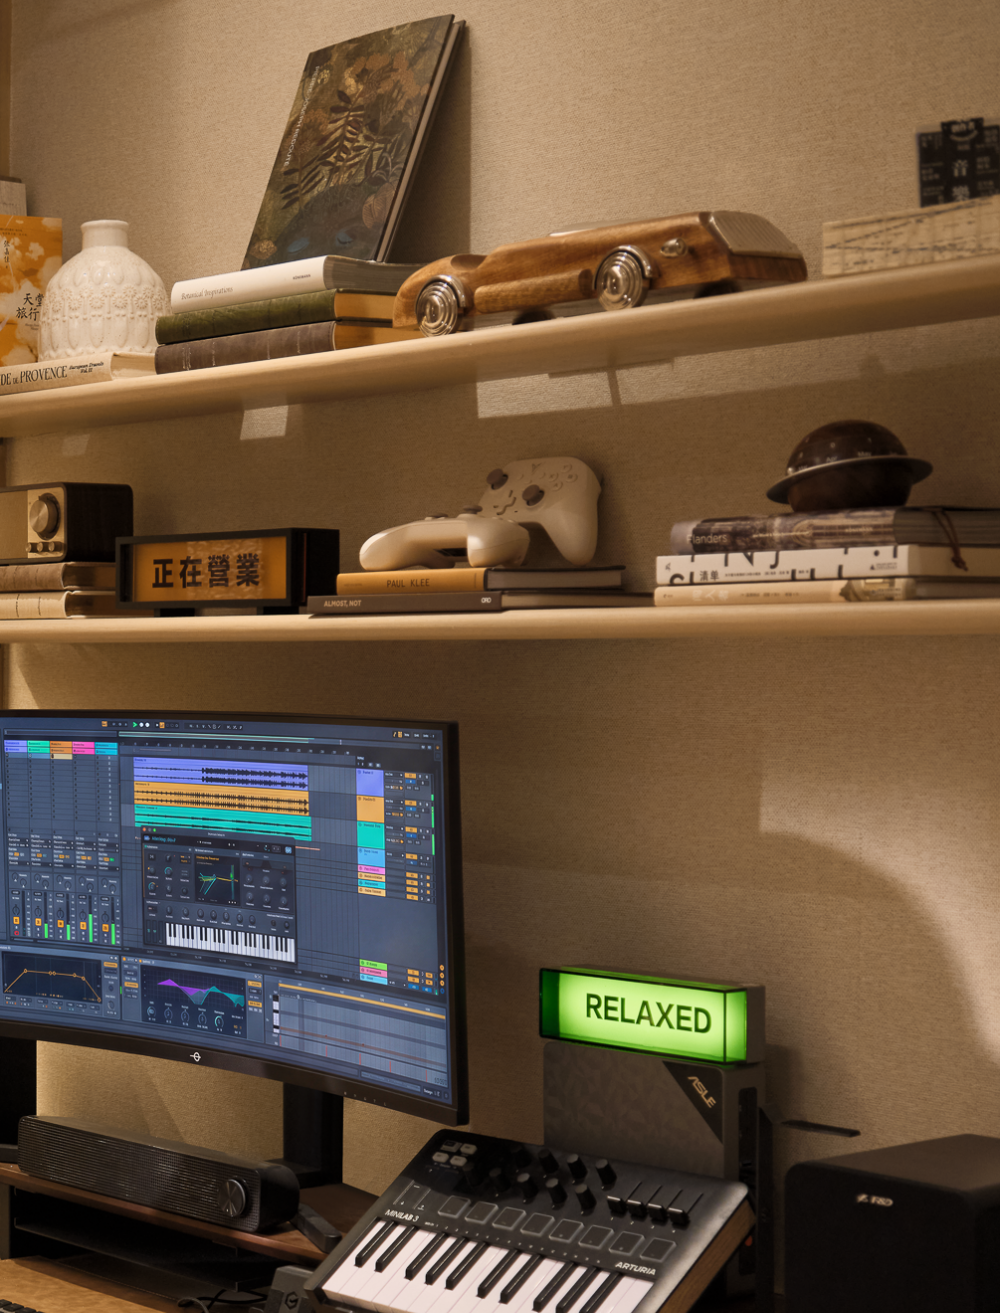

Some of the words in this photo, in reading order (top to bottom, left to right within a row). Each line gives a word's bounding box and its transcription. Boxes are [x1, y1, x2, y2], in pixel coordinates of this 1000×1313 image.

[181, 287, 205, 300] Botanical
[204, 285, 234, 299] Inspirations
[23, 293, 45, 308] 天堂
[15, 307, 40, 321] 旅行
[19, 365, 68, 384] PROVENCE
[686, 533, 728, 545] Flanders
[151, 552, 261, 589] 正在營業
[699, 570, 720, 582] 清单
[386, 579, 405, 588] PAUL
[410, 578, 430, 587] KLEE
[323, 600, 349, 608] ALMOST,
[349, 599, 362, 607] NOT
[586, 992, 712, 1034] RELAXED
[384, 1208, 414, 1221] MINILAB
[412, 1214, 419, 1222] 3
[614, 1261, 657, 1276] ARTURIA
